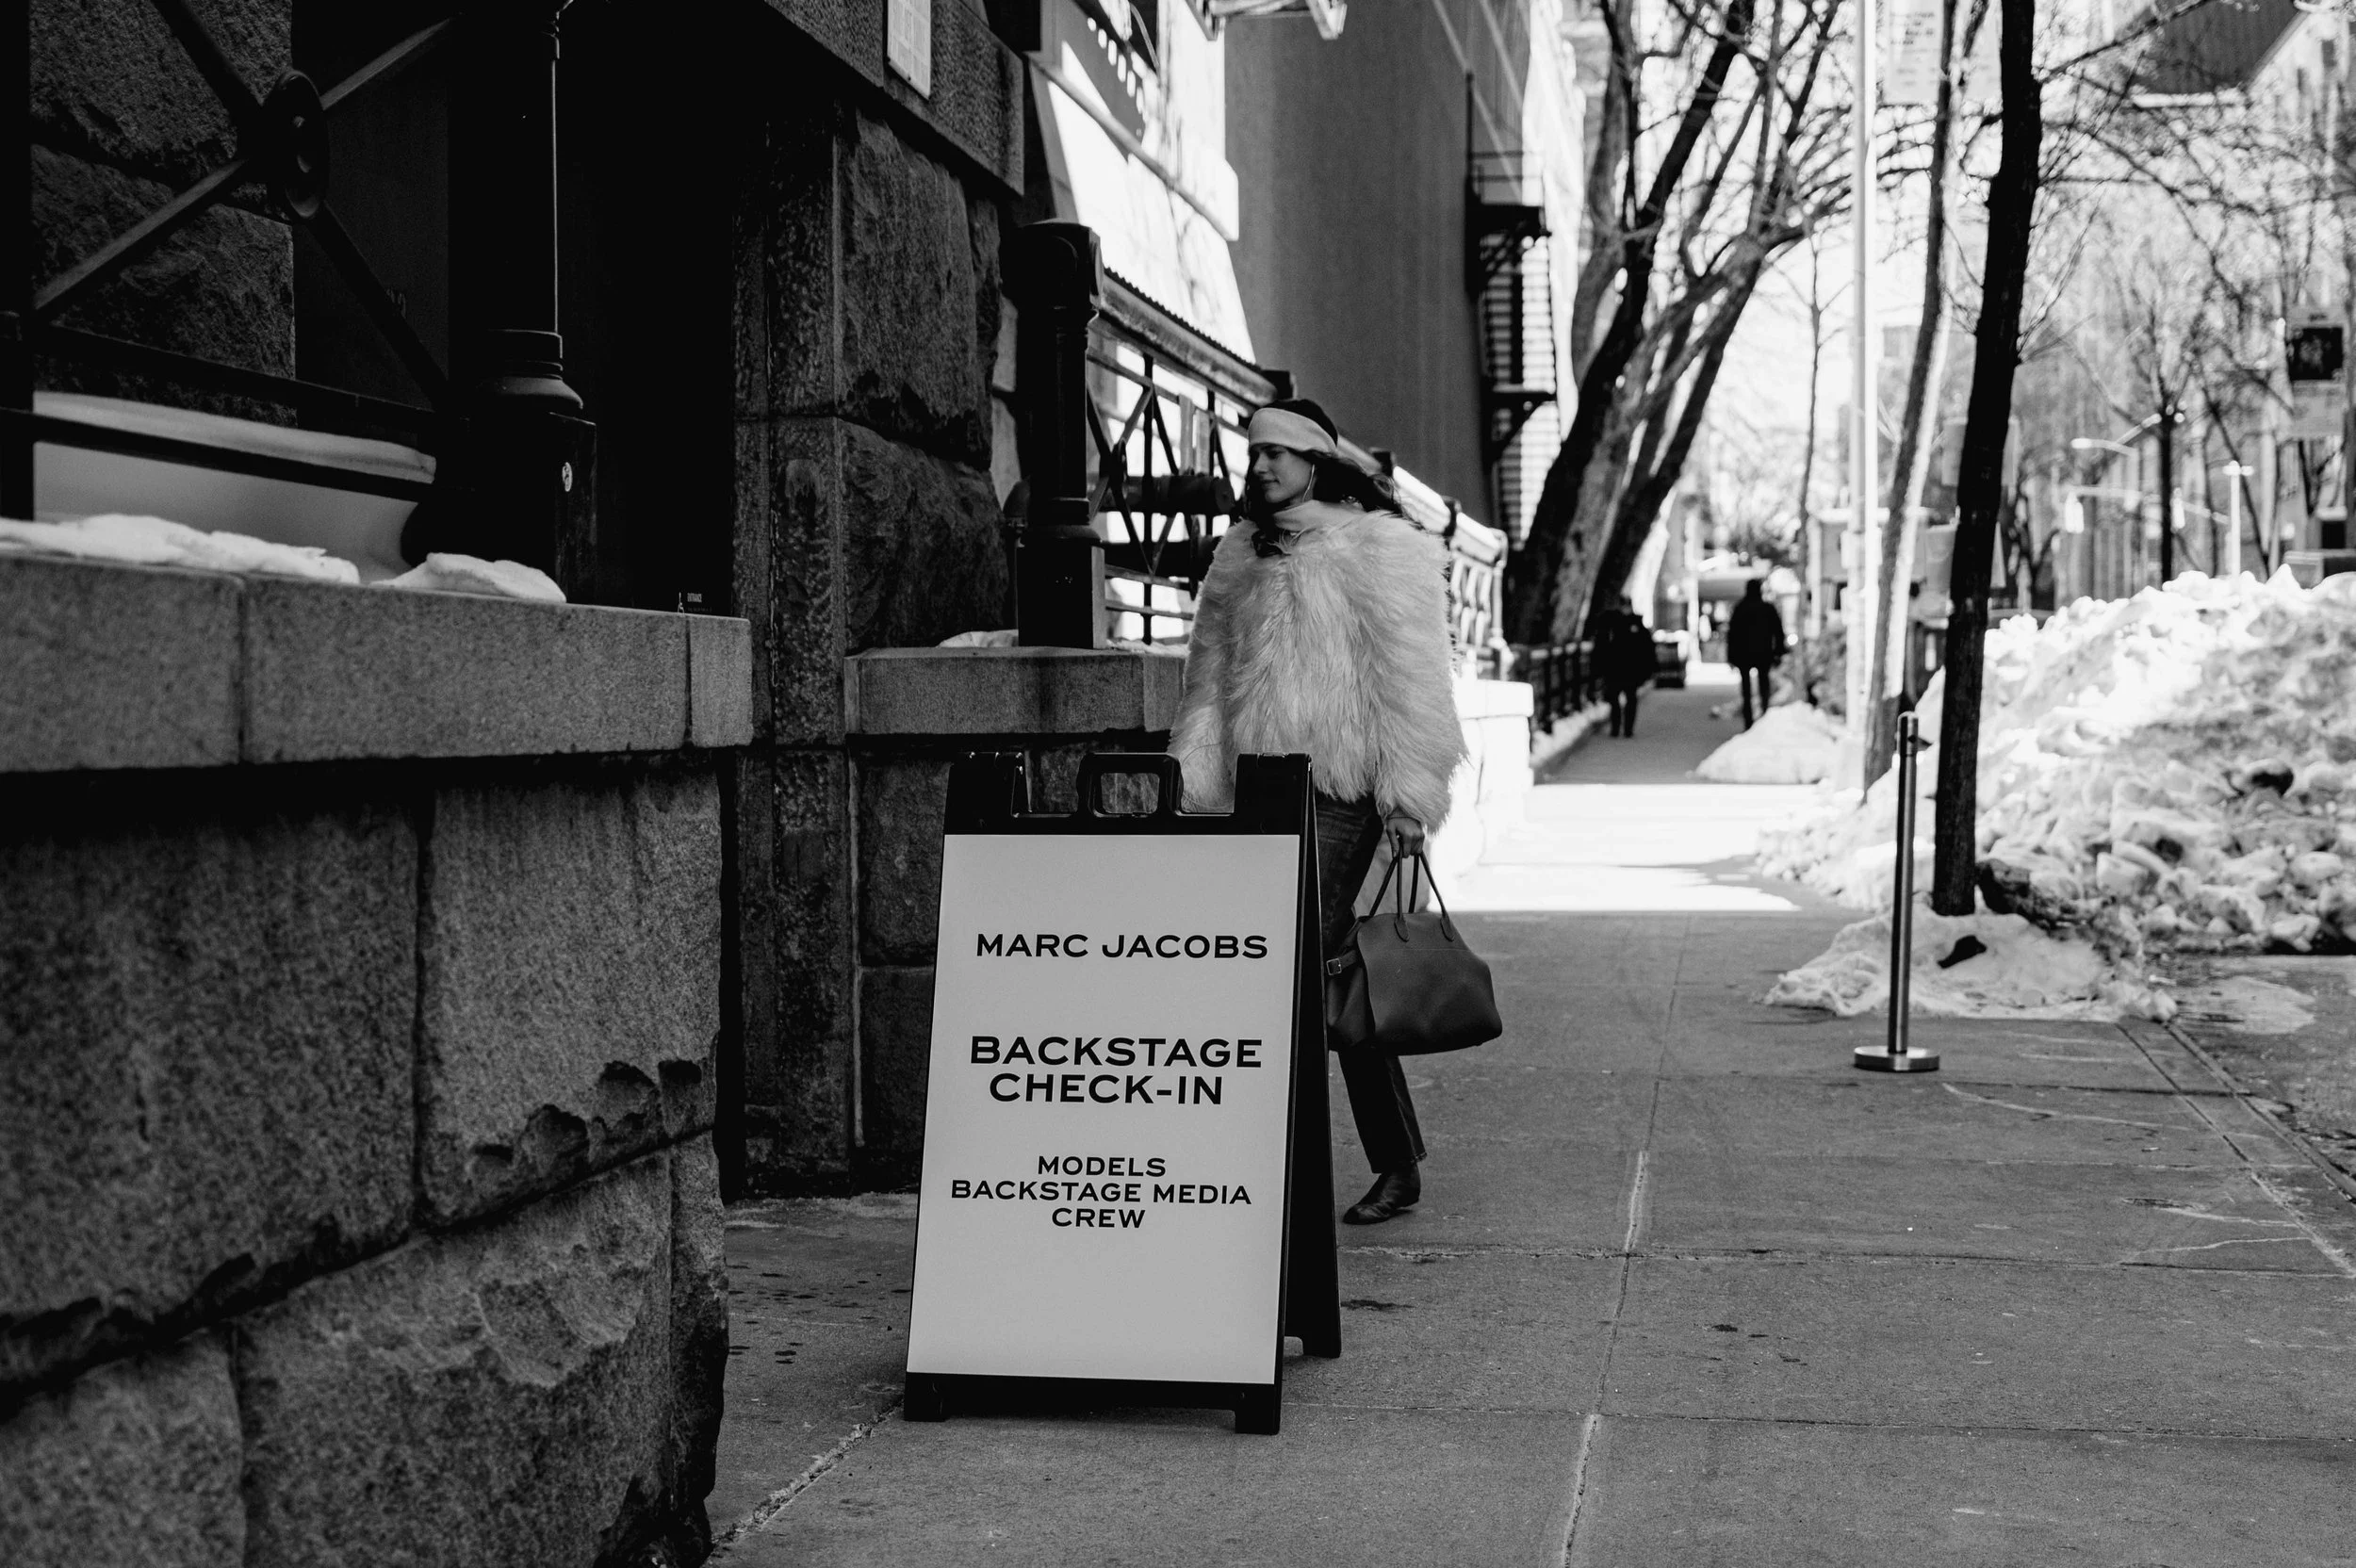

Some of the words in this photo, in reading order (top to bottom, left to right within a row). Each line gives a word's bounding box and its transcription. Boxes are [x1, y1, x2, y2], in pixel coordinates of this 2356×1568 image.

[976, 933, 1088, 958] MARC
[1102, 934, 1268, 959] JACOBS
[970, 1036, 1263, 1069] BACKSTAGE
[989, 1072, 1222, 1105] CHECK-IN
[1038, 1155, 1167, 1178] MODELS
[951, 1179, 1142, 1202] BACKSTAGE
[1153, 1184, 1252, 1205] MEDIA
[1052, 1207, 1146, 1229] CREW
